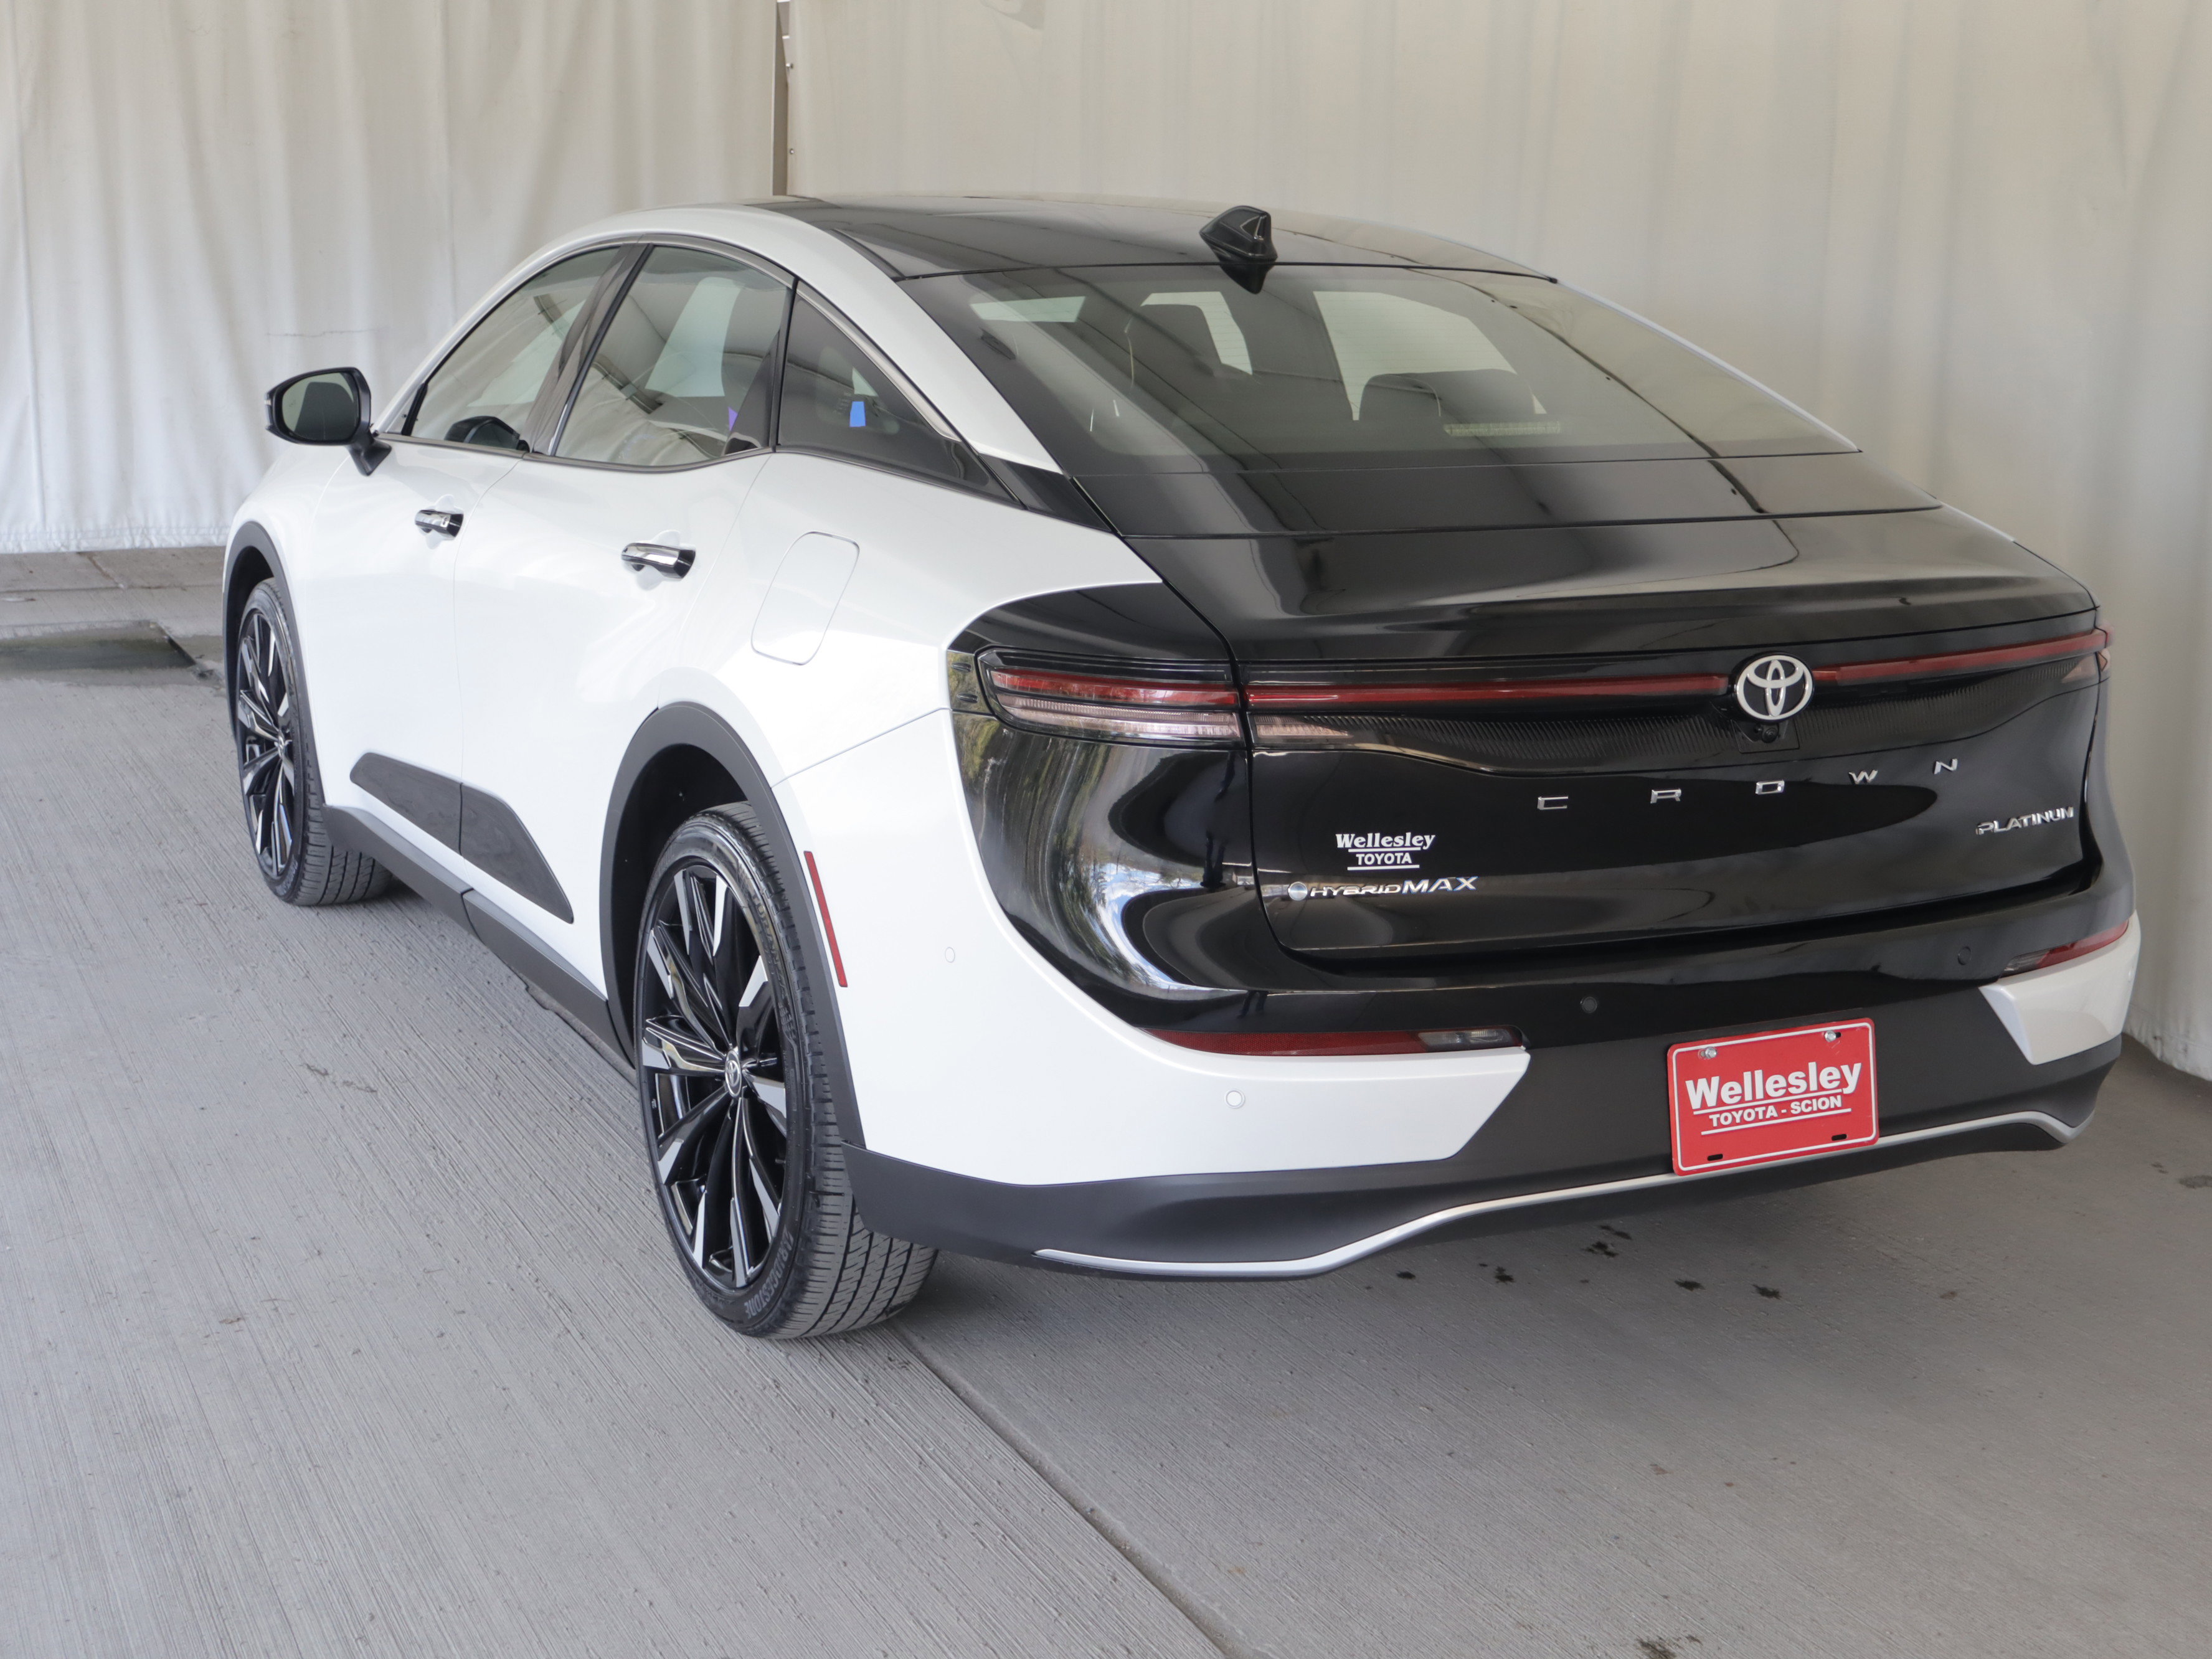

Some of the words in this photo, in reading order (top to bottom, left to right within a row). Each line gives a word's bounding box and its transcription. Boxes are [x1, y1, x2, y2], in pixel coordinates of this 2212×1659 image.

[1975, 806, 2074, 835] PLATINUM
[1335, 832, 1436, 850] Wellesley
[1356, 853, 1412, 866] TOYOTA
[1685, 1061, 1862, 1110] Wellesley
[1709, 1105, 1779, 1127] TOYOTA
[1790, 1095, 1842, 1115] SCION
